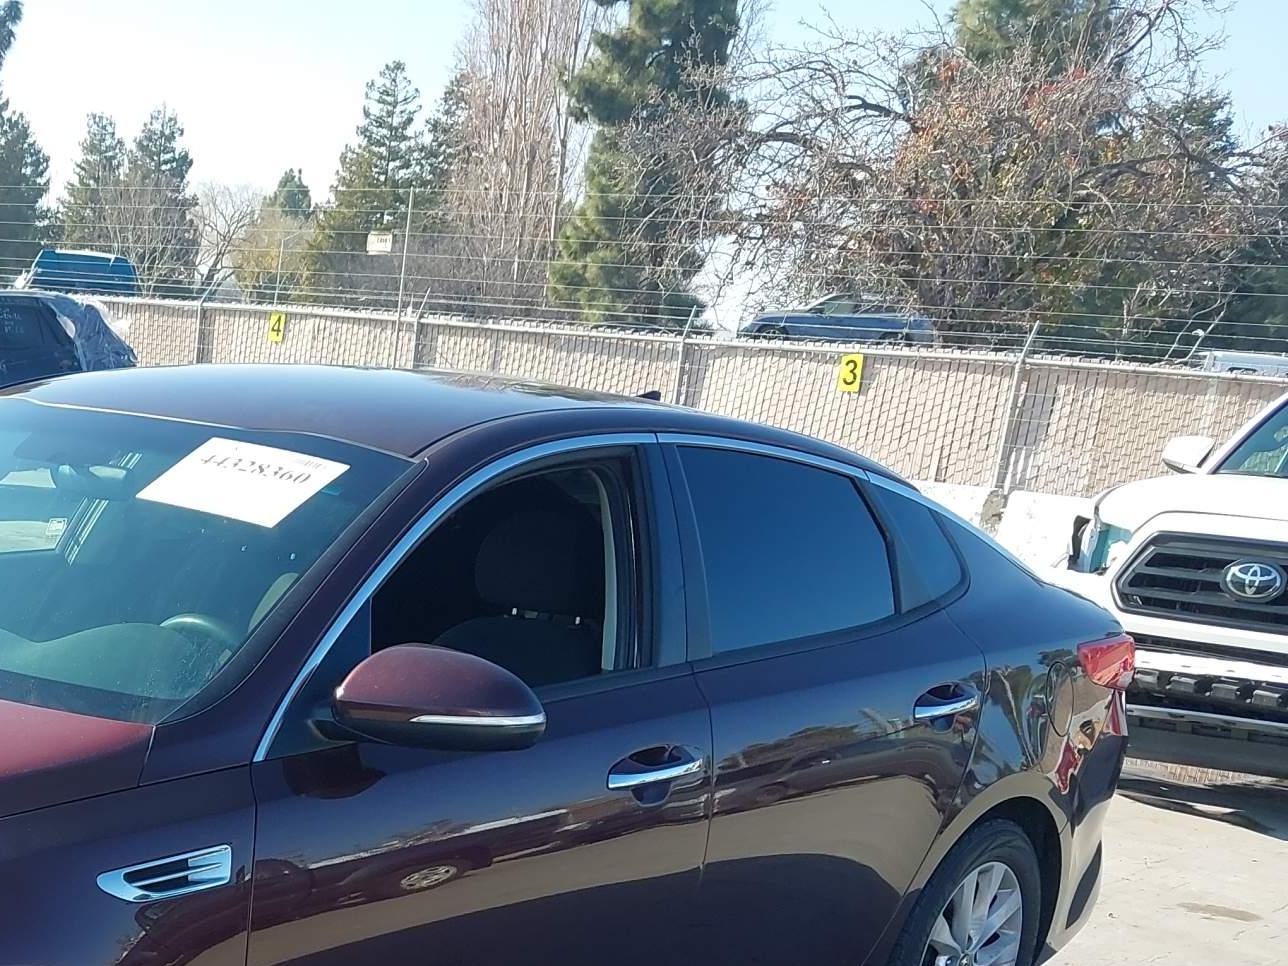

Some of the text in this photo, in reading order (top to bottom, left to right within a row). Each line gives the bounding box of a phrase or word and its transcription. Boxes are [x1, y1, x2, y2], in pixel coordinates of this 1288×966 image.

[271, 315, 282, 337] 4
[842, 359, 858, 386] 3
[200, 454, 312, 484] 44328360
